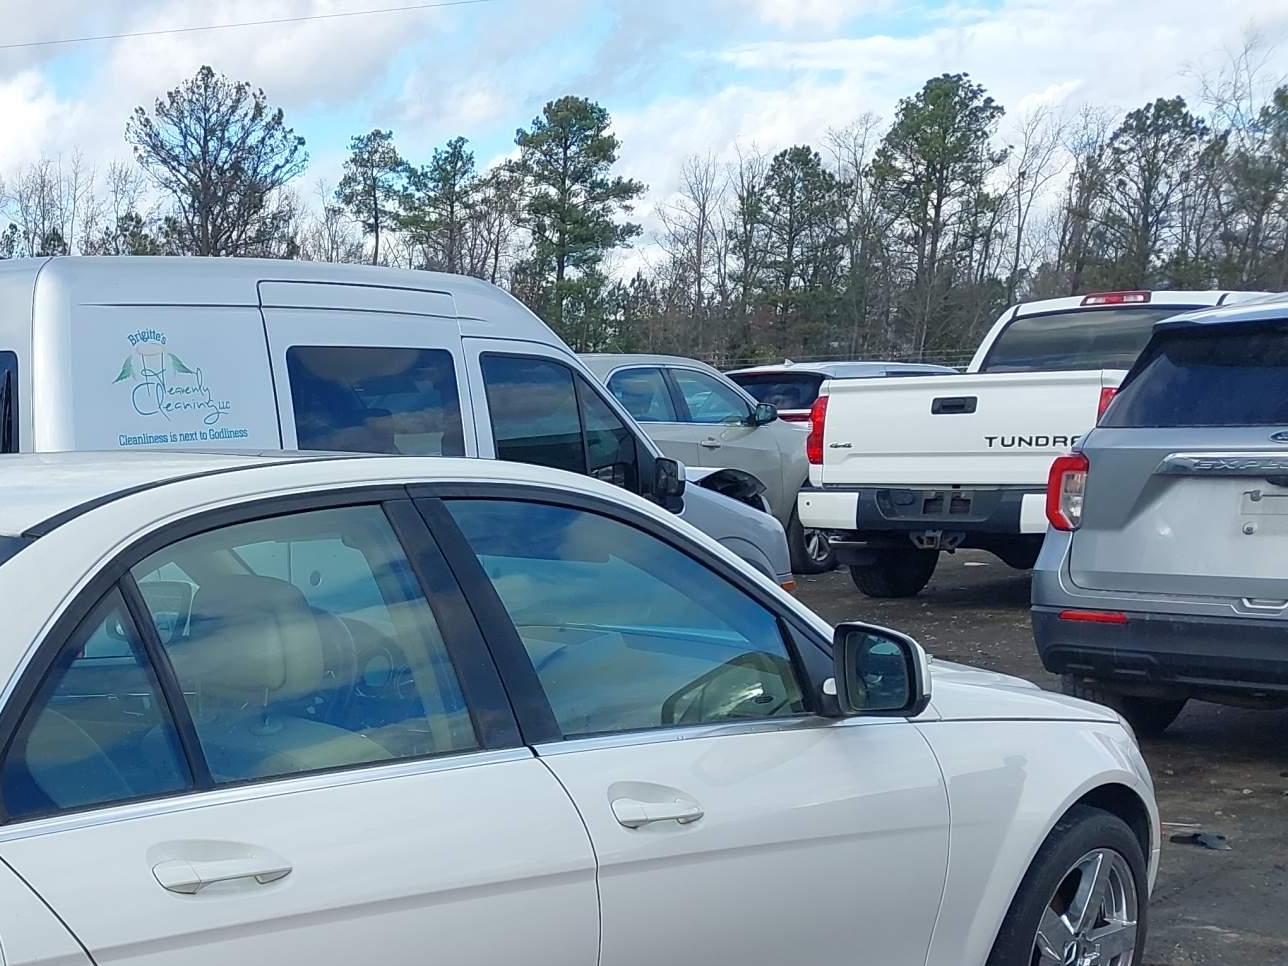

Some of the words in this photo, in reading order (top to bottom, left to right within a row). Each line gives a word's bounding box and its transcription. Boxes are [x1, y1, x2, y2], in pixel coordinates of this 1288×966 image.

[127, 328, 167, 346] Brigitte's
[132, 382, 229, 425] Cleaning
[218, 401, 231, 410] LLC
[118, 432, 169, 446] Cleanliness
[169, 432, 178, 443] is
[179, 430, 198, 442] next
[199, 430, 208, 441] to
[208, 427, 249, 440] Godliness
